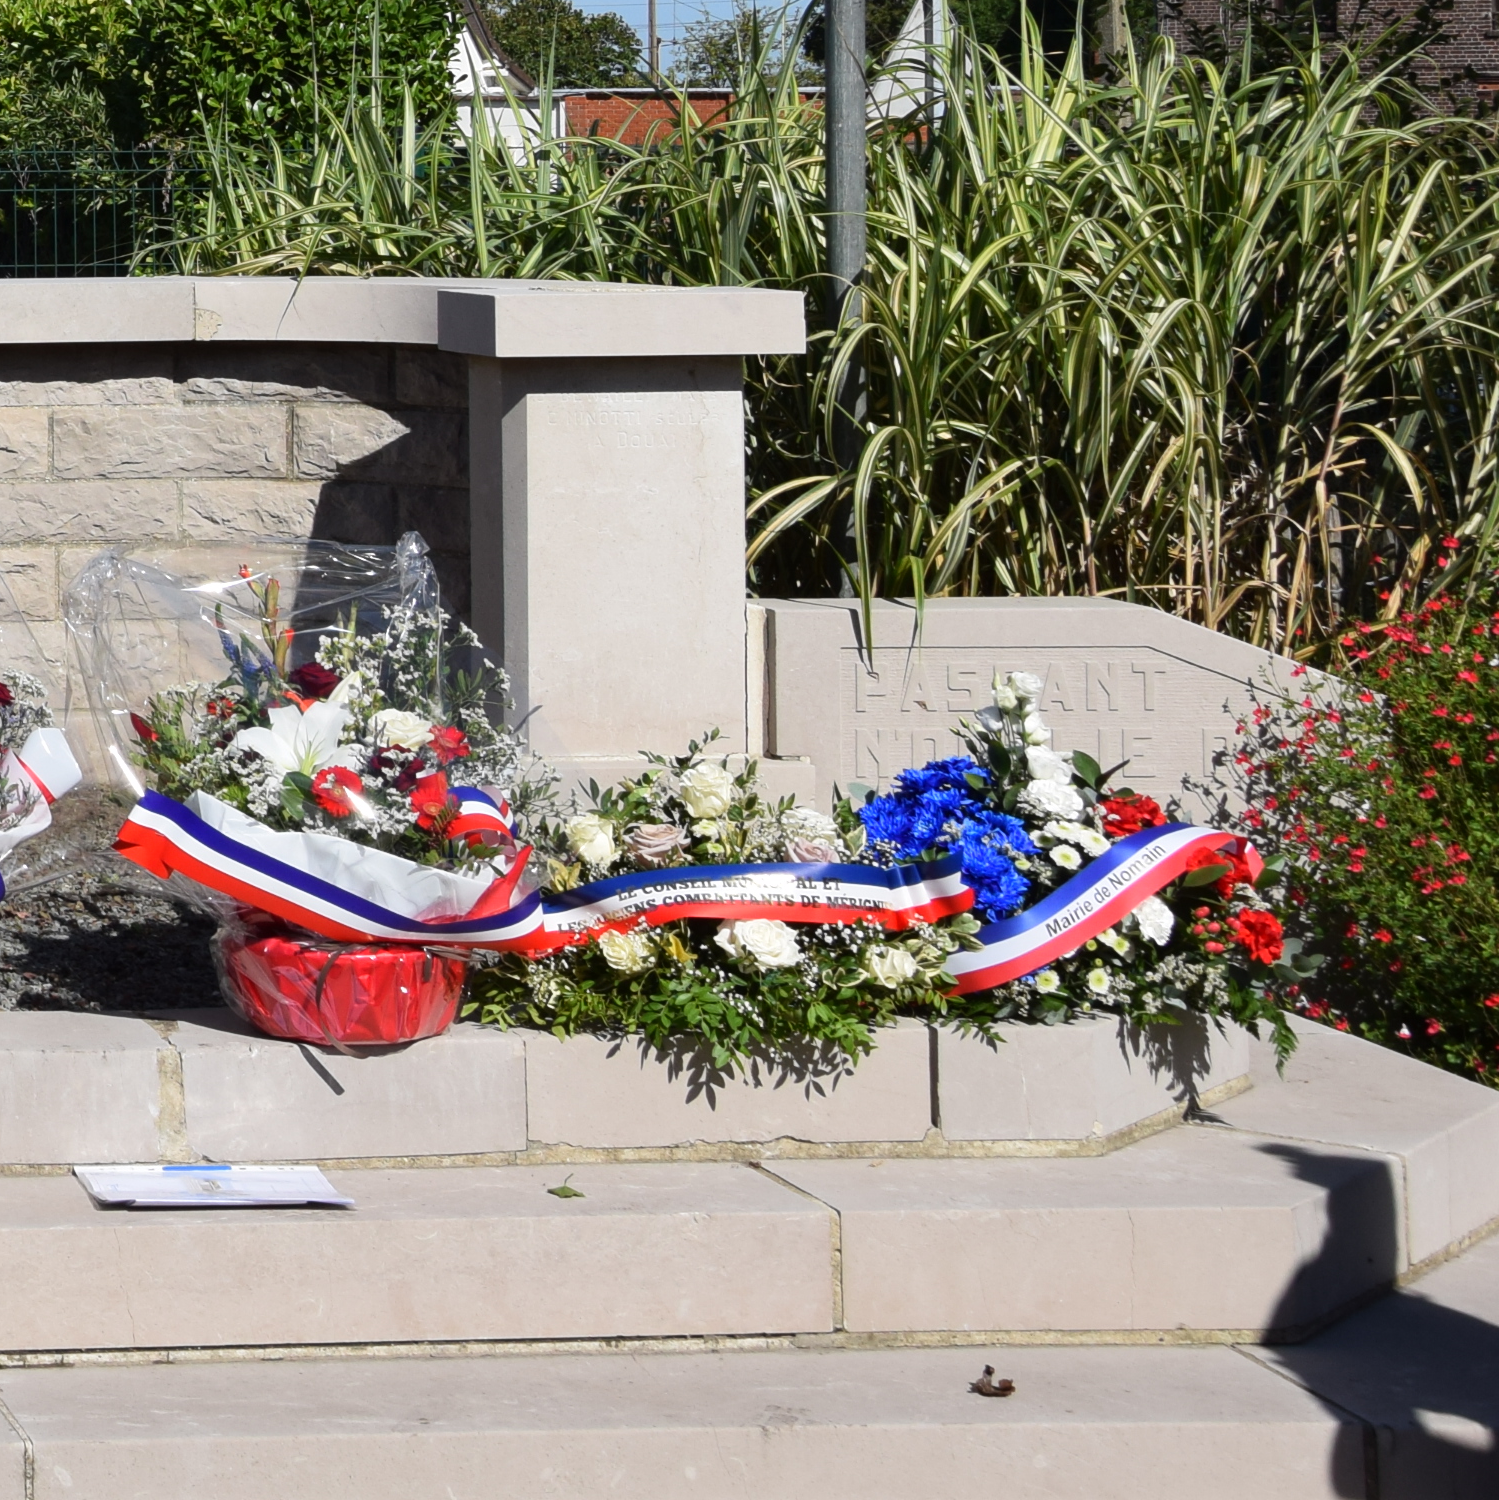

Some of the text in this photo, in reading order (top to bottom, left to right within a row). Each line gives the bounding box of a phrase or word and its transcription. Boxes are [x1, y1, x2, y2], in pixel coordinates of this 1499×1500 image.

[854, 661, 1166, 713] PASANT
[642, 878, 716, 894] CONSEIL
[822, 877, 842, 891] ET
[801, 895, 820, 908] DE
[1045, 844, 1166, 937] Mairie de Nomain
